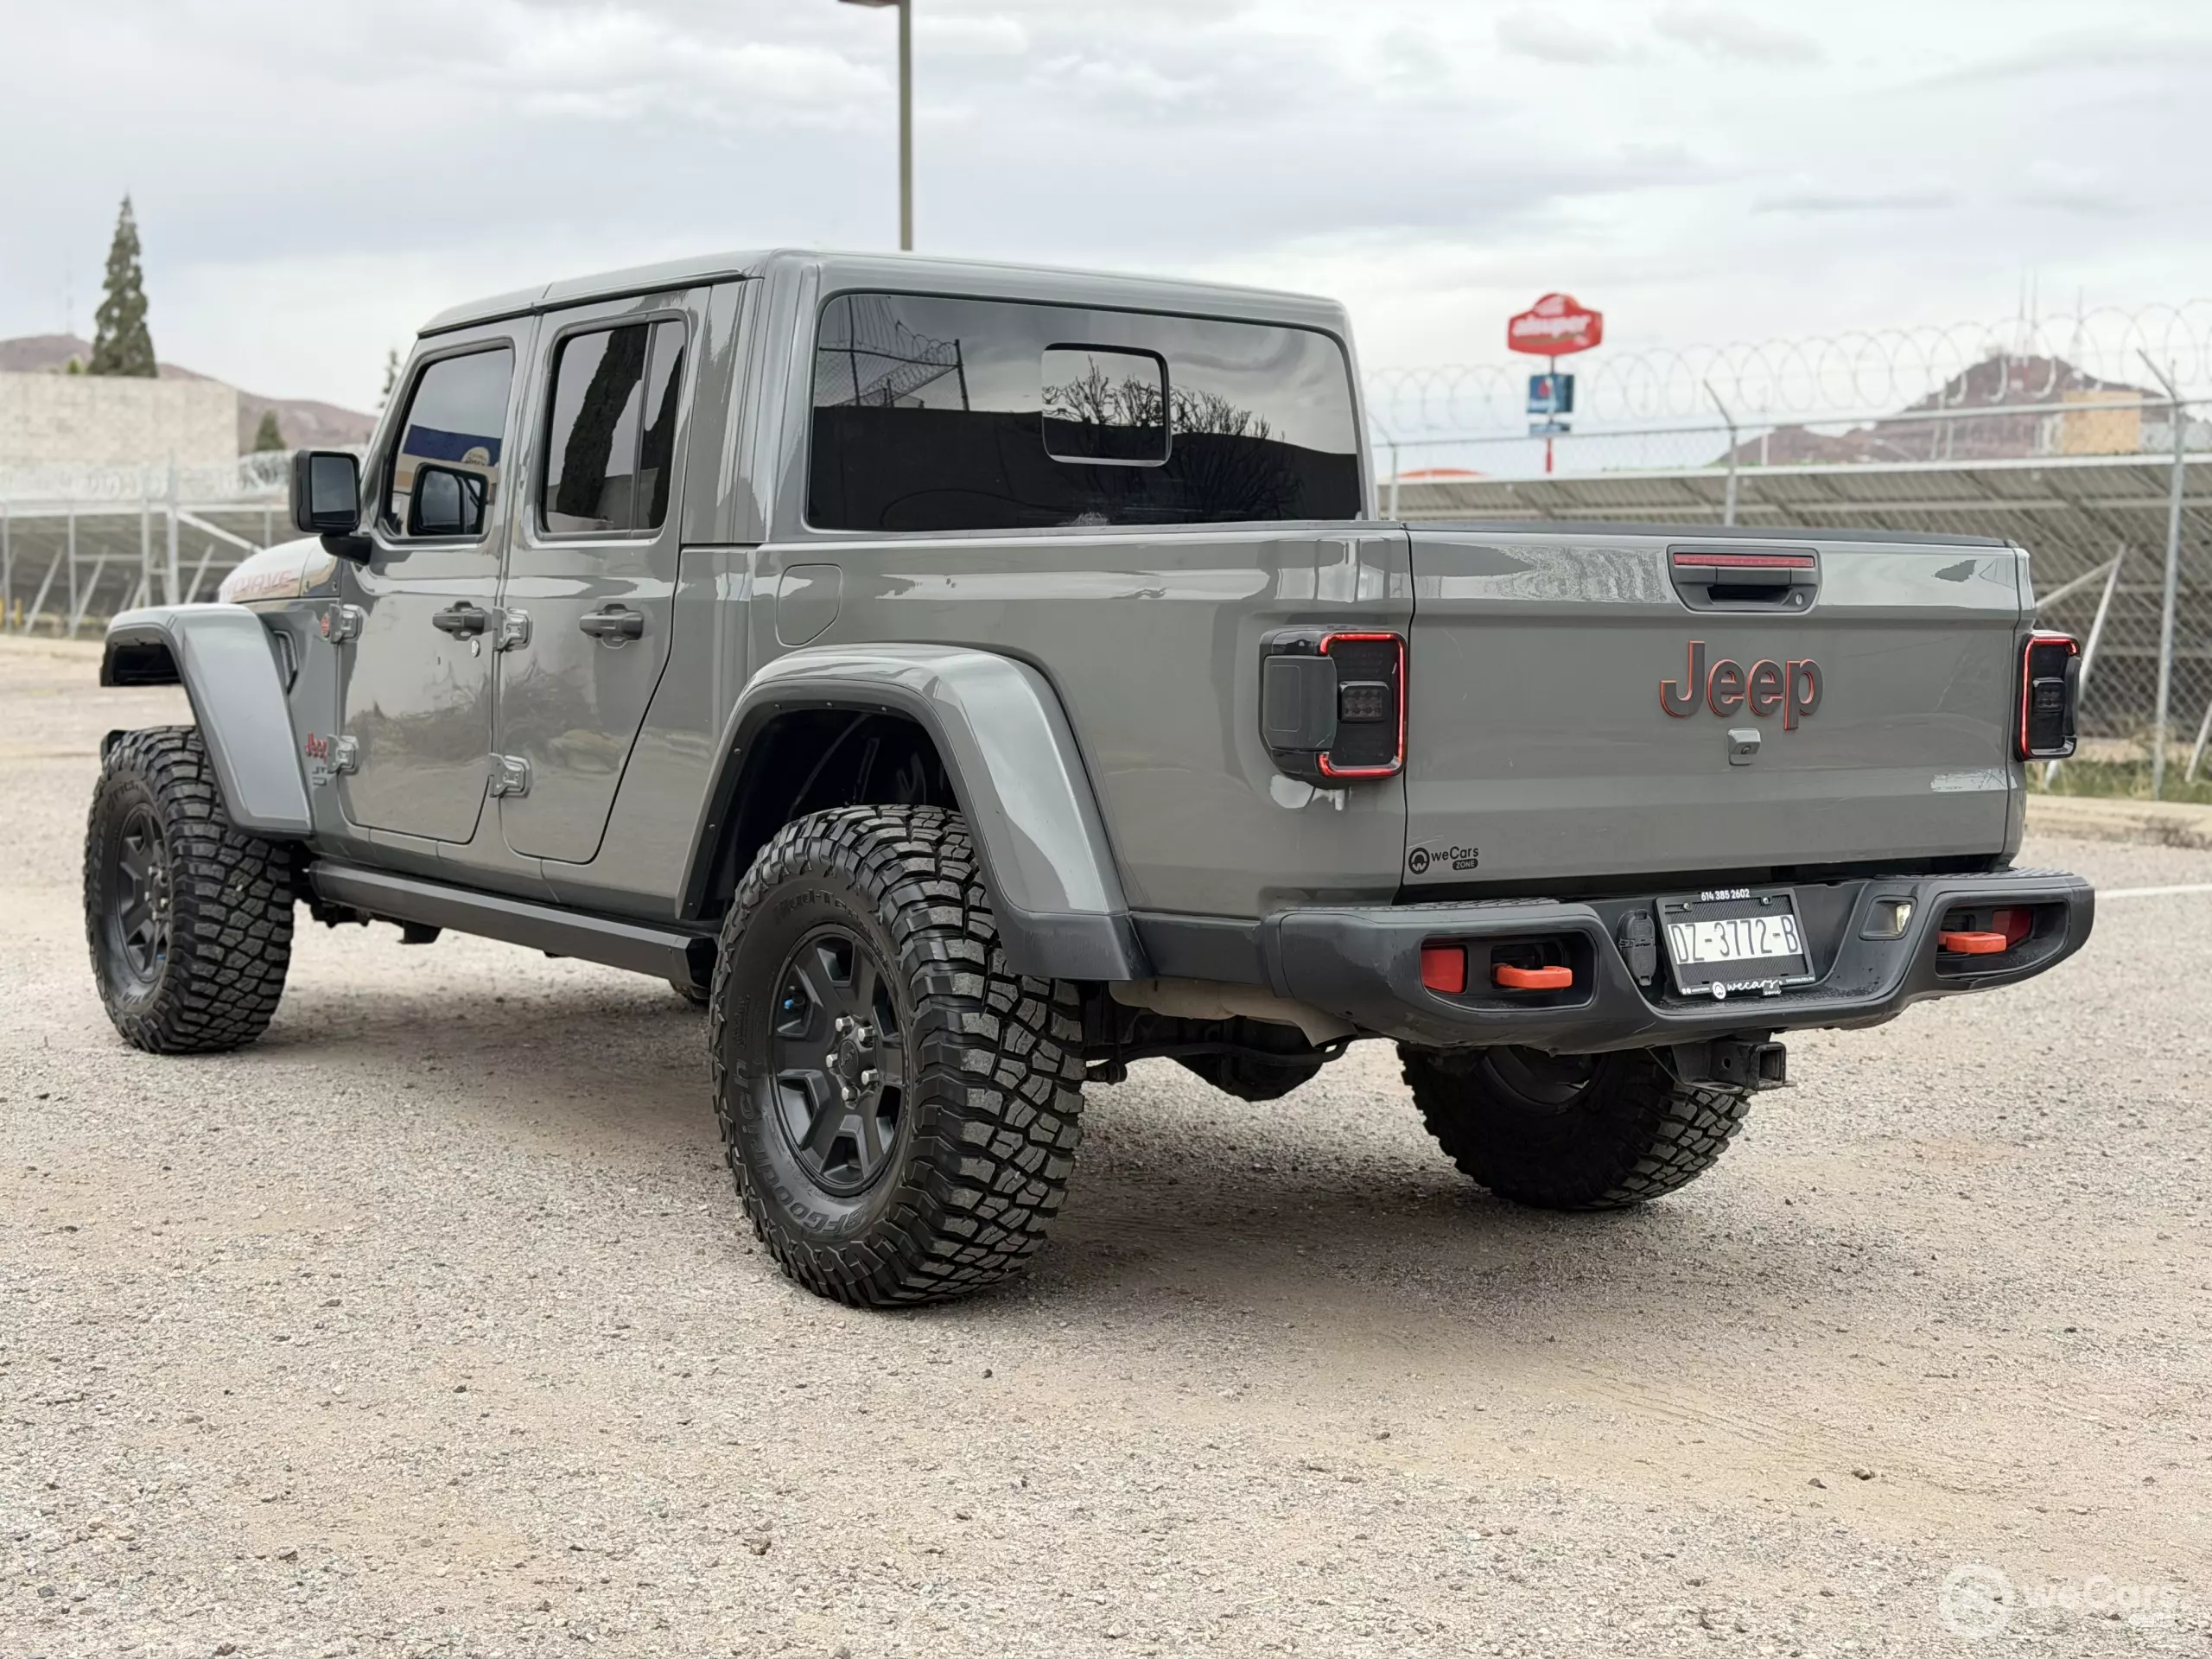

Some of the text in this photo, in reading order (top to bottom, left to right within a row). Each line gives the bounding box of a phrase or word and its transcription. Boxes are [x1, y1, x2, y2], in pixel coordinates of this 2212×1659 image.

[1660, 639, 1823, 730] Jeep
[1431, 846, 1479, 861] weCars
[1455, 860, 1475, 869] ZONE
[1701, 888, 1751, 901] 614 385 2602
[1670, 915, 1799, 963] DZ-3772-B
